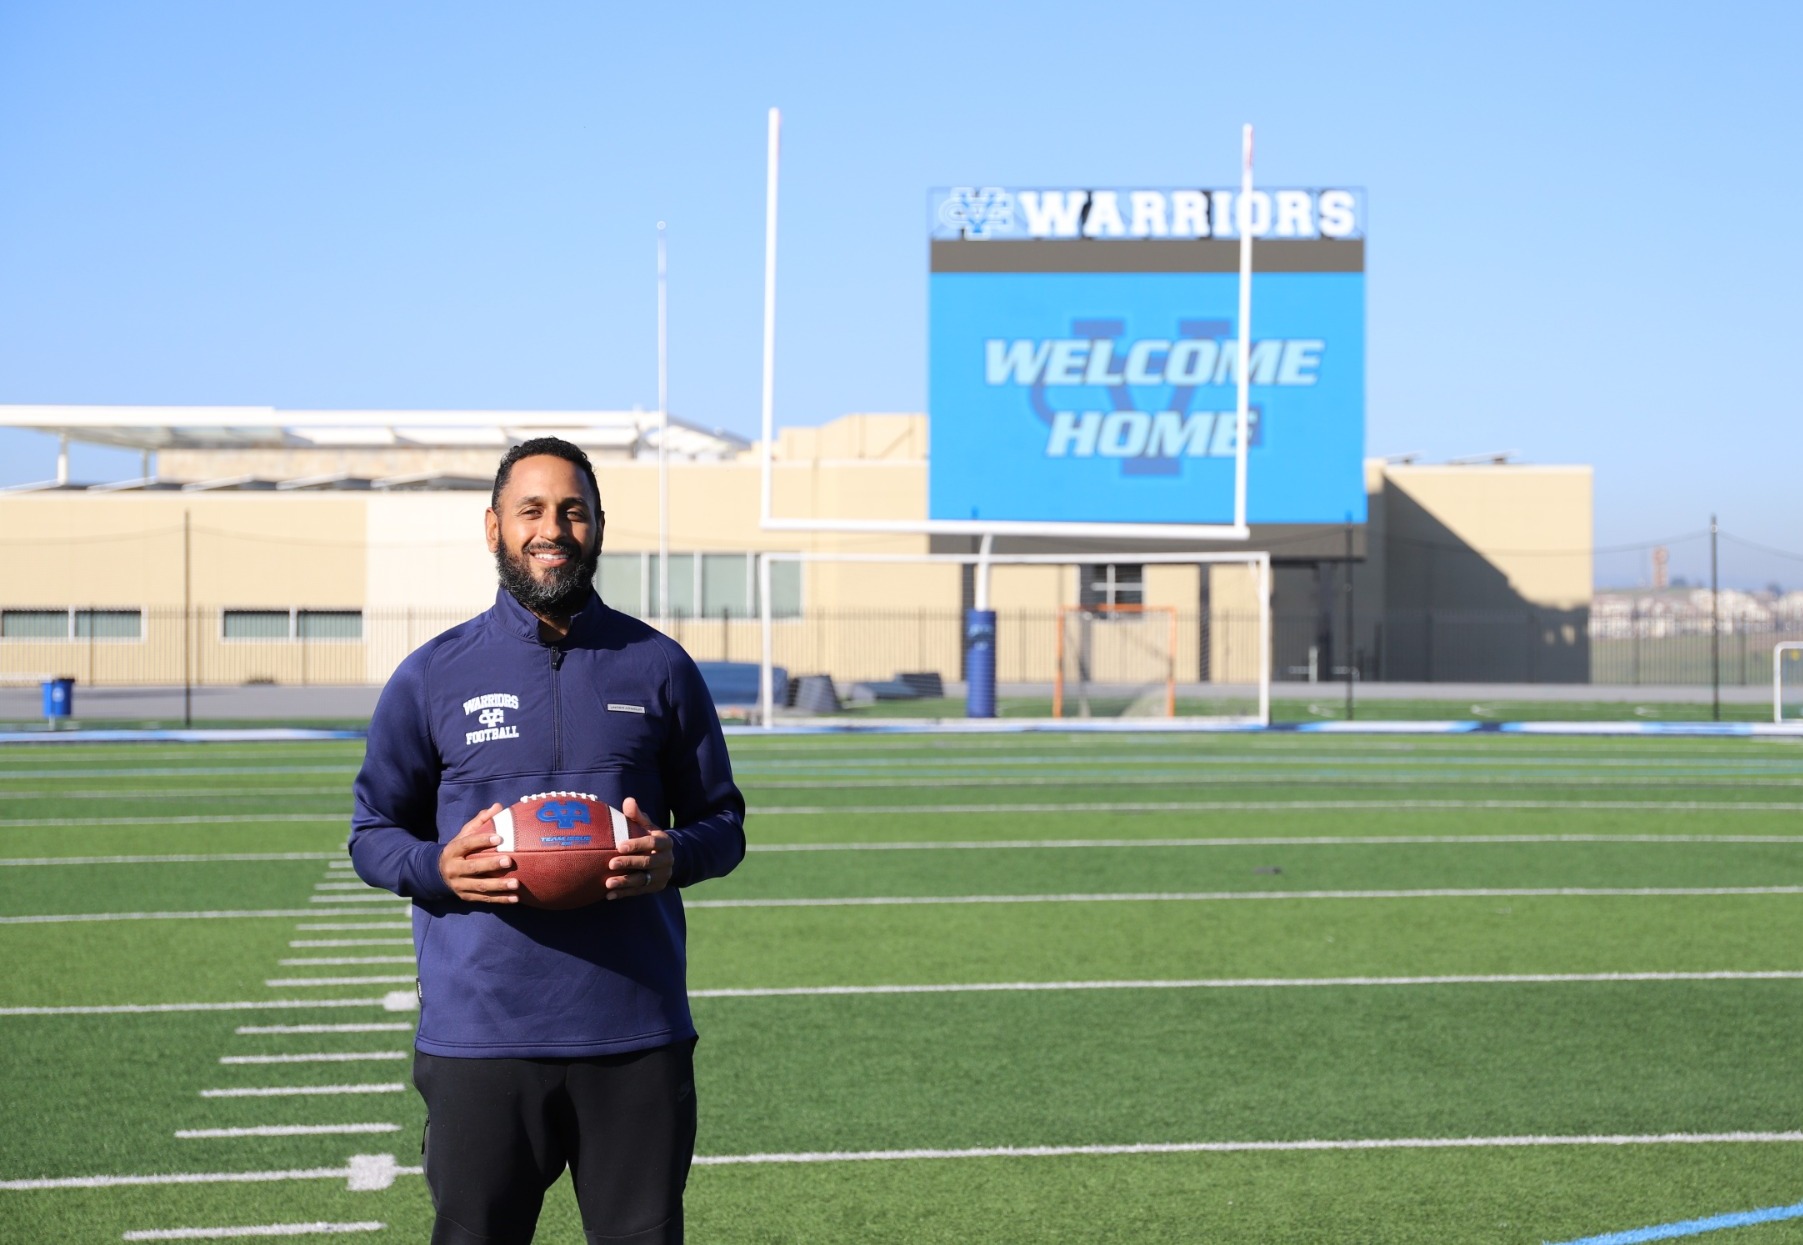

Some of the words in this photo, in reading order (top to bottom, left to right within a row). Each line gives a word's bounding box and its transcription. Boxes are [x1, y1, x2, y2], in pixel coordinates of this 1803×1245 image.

[1017, 190, 1356, 237] WARRIORS
[985, 339, 1325, 385] WELCOME
[1046, 411, 1258, 457] HOME
[463, 693, 519, 715] WARRIORS
[466, 725, 519, 745] FOOTBALL
